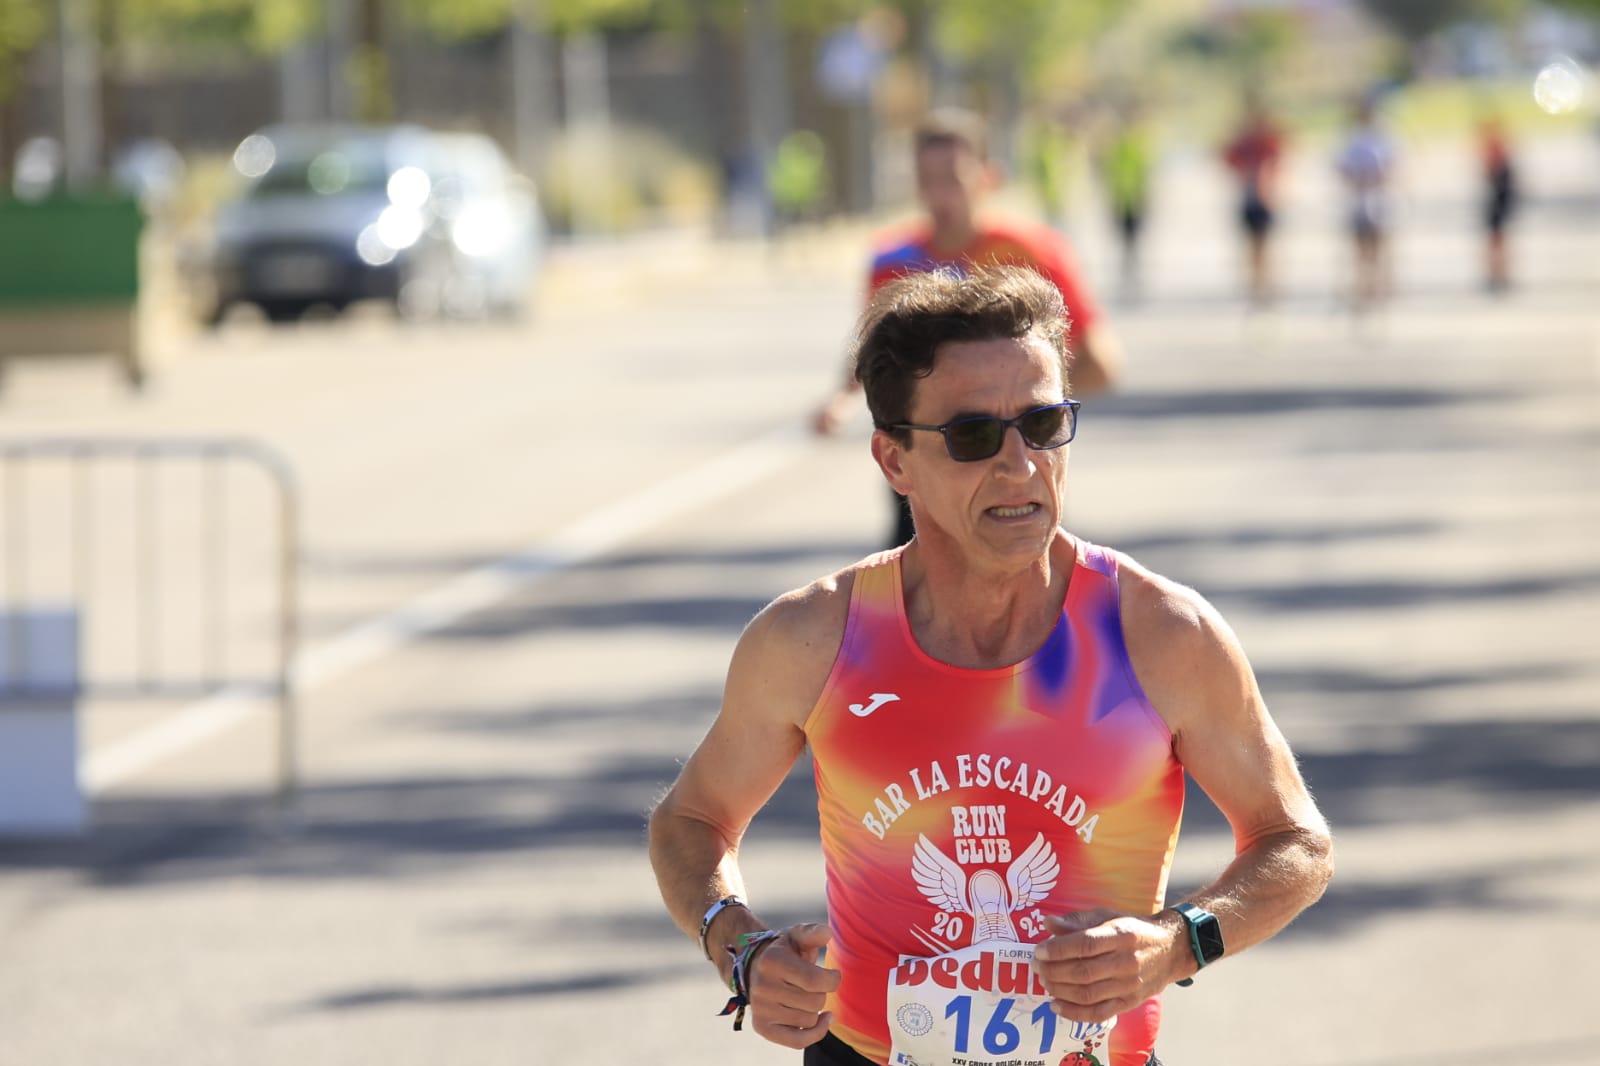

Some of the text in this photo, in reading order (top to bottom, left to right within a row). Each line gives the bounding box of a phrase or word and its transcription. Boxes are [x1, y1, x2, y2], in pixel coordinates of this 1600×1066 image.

[862, 754, 1100, 844] BAR LA ESCAPADA
[951, 805, 1006, 837] RUN
[955, 838, 1012, 864] CLUB
[930, 911, 964, 942] 20
[998, 949, 1035, 959] FLORIS
[944, 995, 1057, 1056] 161
[952, 1057, 966, 1066] XXV
